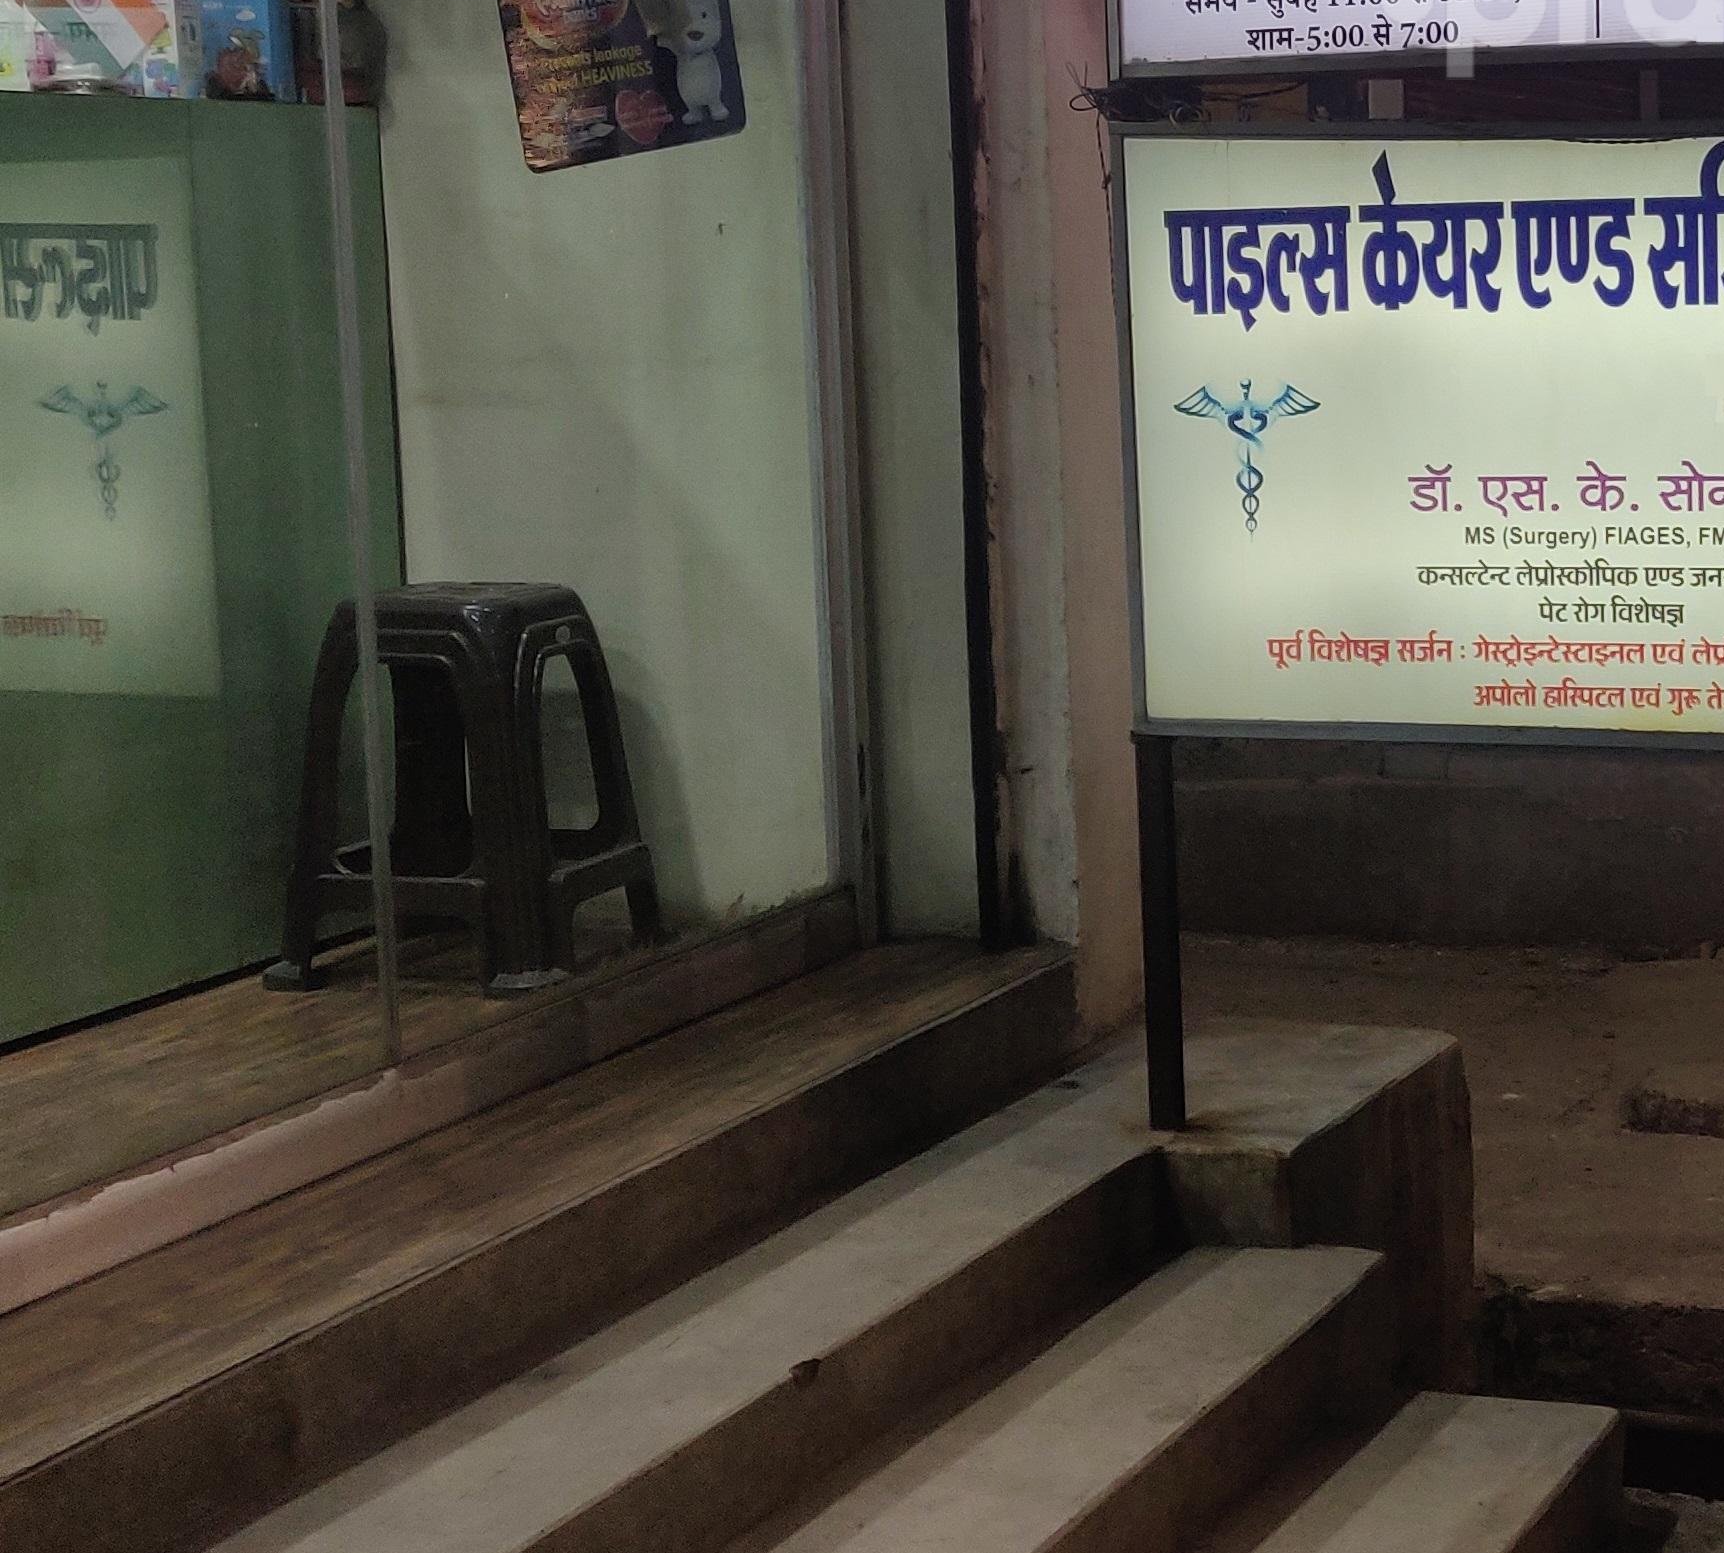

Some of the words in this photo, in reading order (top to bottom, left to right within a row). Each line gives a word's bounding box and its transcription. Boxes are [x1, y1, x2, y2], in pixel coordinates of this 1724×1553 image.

[1370, 13, 1393, 48] से
[1399, 20, 1460, 48] 7:00
[1163, 205, 1351, 332] पाइल्स
[1358, 148, 1505, 313] केयर
[1510, 197, 1636, 309] एण्ड
[1407, 463, 1463, 512] डॉ.
[1477, 476, 1560, 518] एस.
[1575, 460, 1639, 512] के.
[1465, 526, 1496, 545] MS
[1502, 526, 1597, 550] (Surgery)
[1605, 526, 1691, 548] FIAGES,
[1416, 559, 1511, 586] कन्सल्टेन्ट
[1514, 557, 1639, 587] लेप्रोस्कोपिक
[1642, 567, 1685, 587] एण्ड
[1538, 596, 1568, 623] पेट
[1571, 596, 1607, 623] रोग
[1610, 594, 1685, 628] विशेषज्ञ
[1266, 629, 1304, 670] पूर्व
[1307, 628, 1391, 667] विशेषज्ञ
[1395, 629, 1454, 663] सर्जन
[1650, 638, 1686, 665] एवं
[1473, 678, 1537, 707] अपोलो
[1629, 682, 1662, 709] एवं
